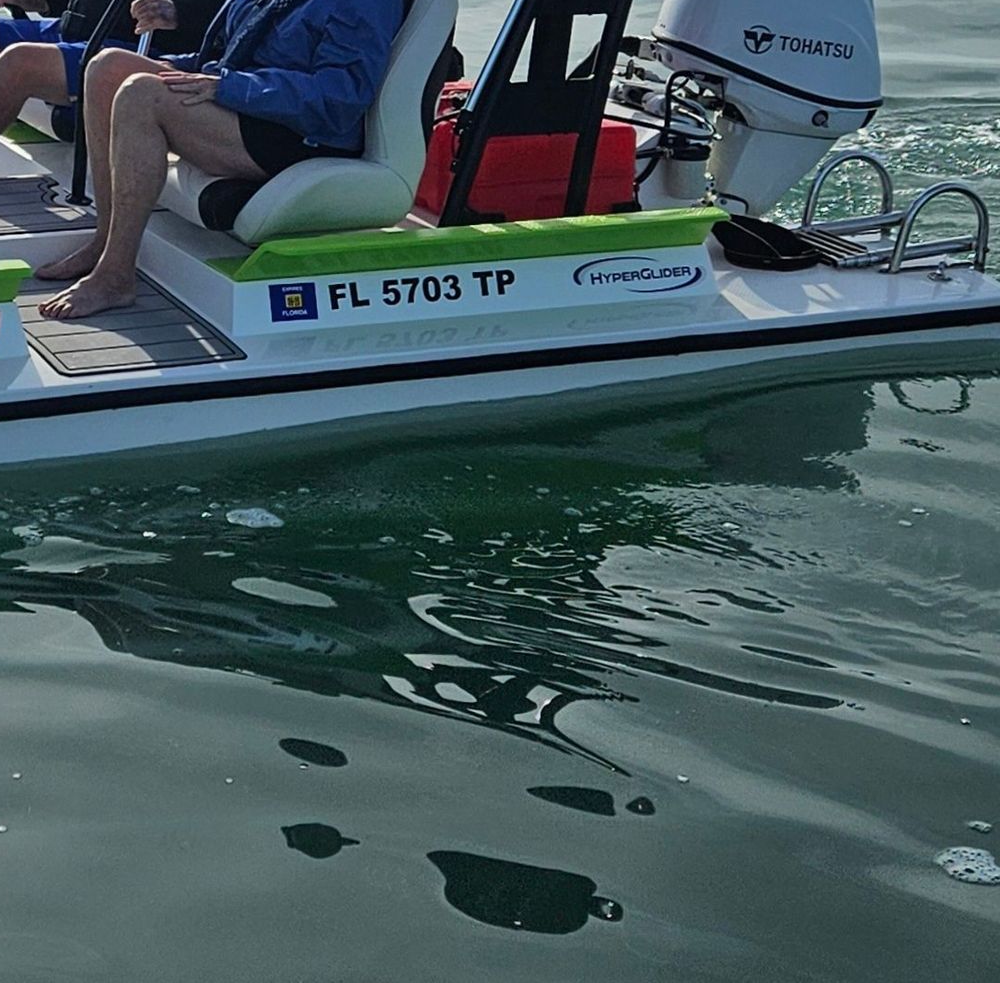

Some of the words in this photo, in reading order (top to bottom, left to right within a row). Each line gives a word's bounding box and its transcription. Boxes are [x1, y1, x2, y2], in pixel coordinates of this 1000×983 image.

[779, 35, 854, 59] TOHATSU
[590, 266, 692, 285] HYPERGLIDER
[328, 282, 370, 310] FL
[382, 274, 462, 306] 5703
[472, 269, 515, 296] TP
